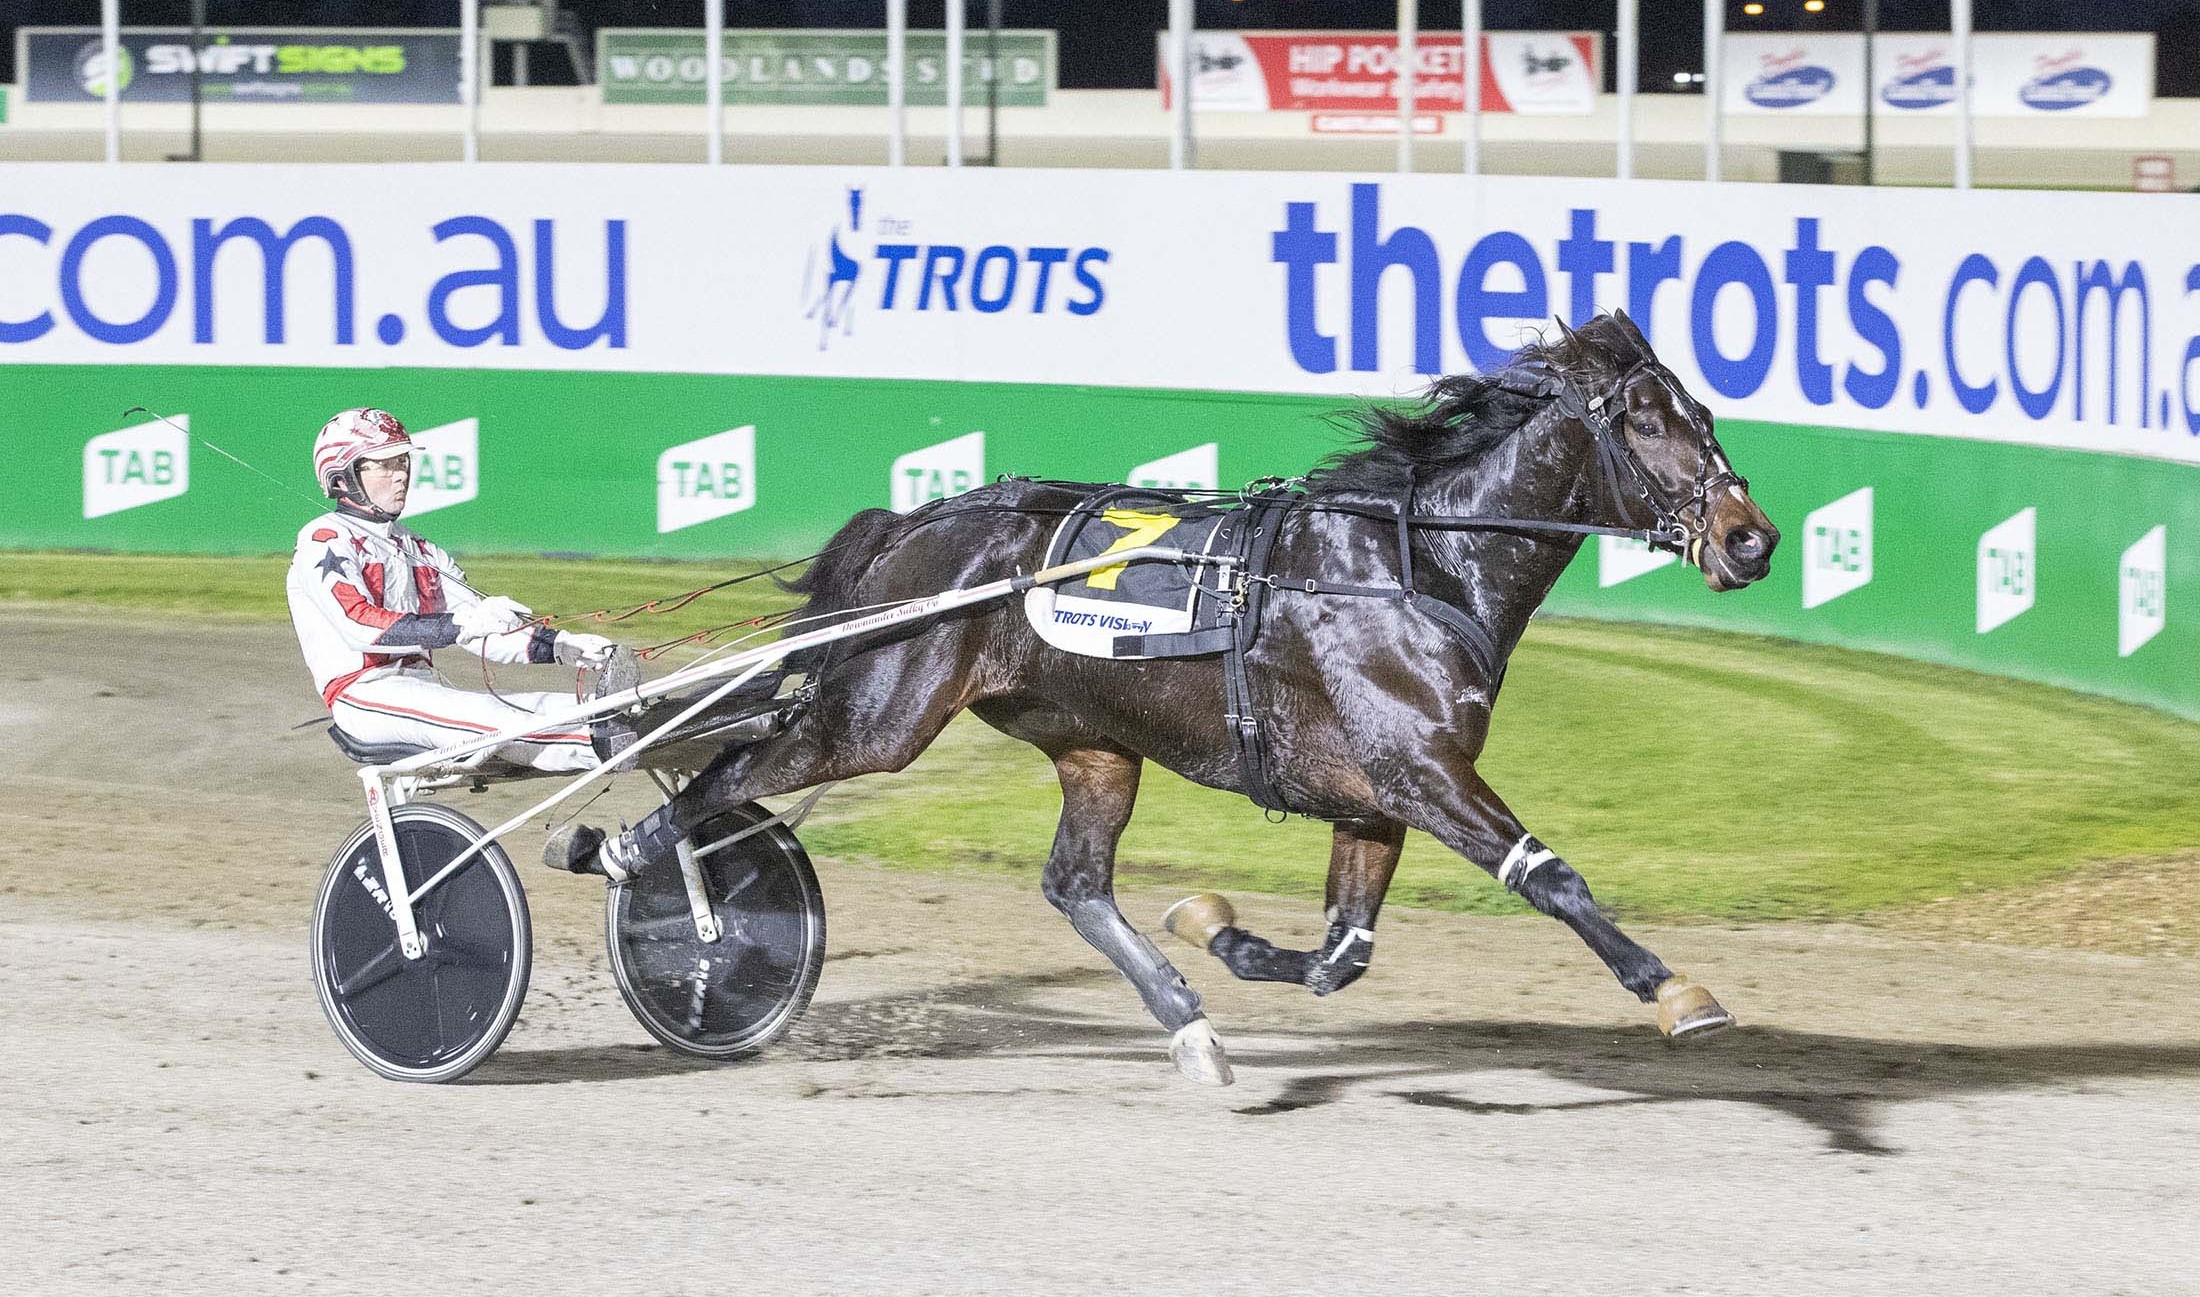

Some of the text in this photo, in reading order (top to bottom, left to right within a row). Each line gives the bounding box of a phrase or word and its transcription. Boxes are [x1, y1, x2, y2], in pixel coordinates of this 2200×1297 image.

[1289, 45, 1343, 74] HIP
[875, 244, 1112, 317] TROTS
[98, 449, 174, 485] TAB
[414, 452, 465, 490] AB
[672, 461, 741, 499] TAB
[904, 467, 970, 505] TAB
[1086, 508, 1182, 590] 7
[1814, 525, 1861, 573] TAB
[1986, 547, 2025, 596] TAB
[1053, 609, 1097, 627] TROTS
